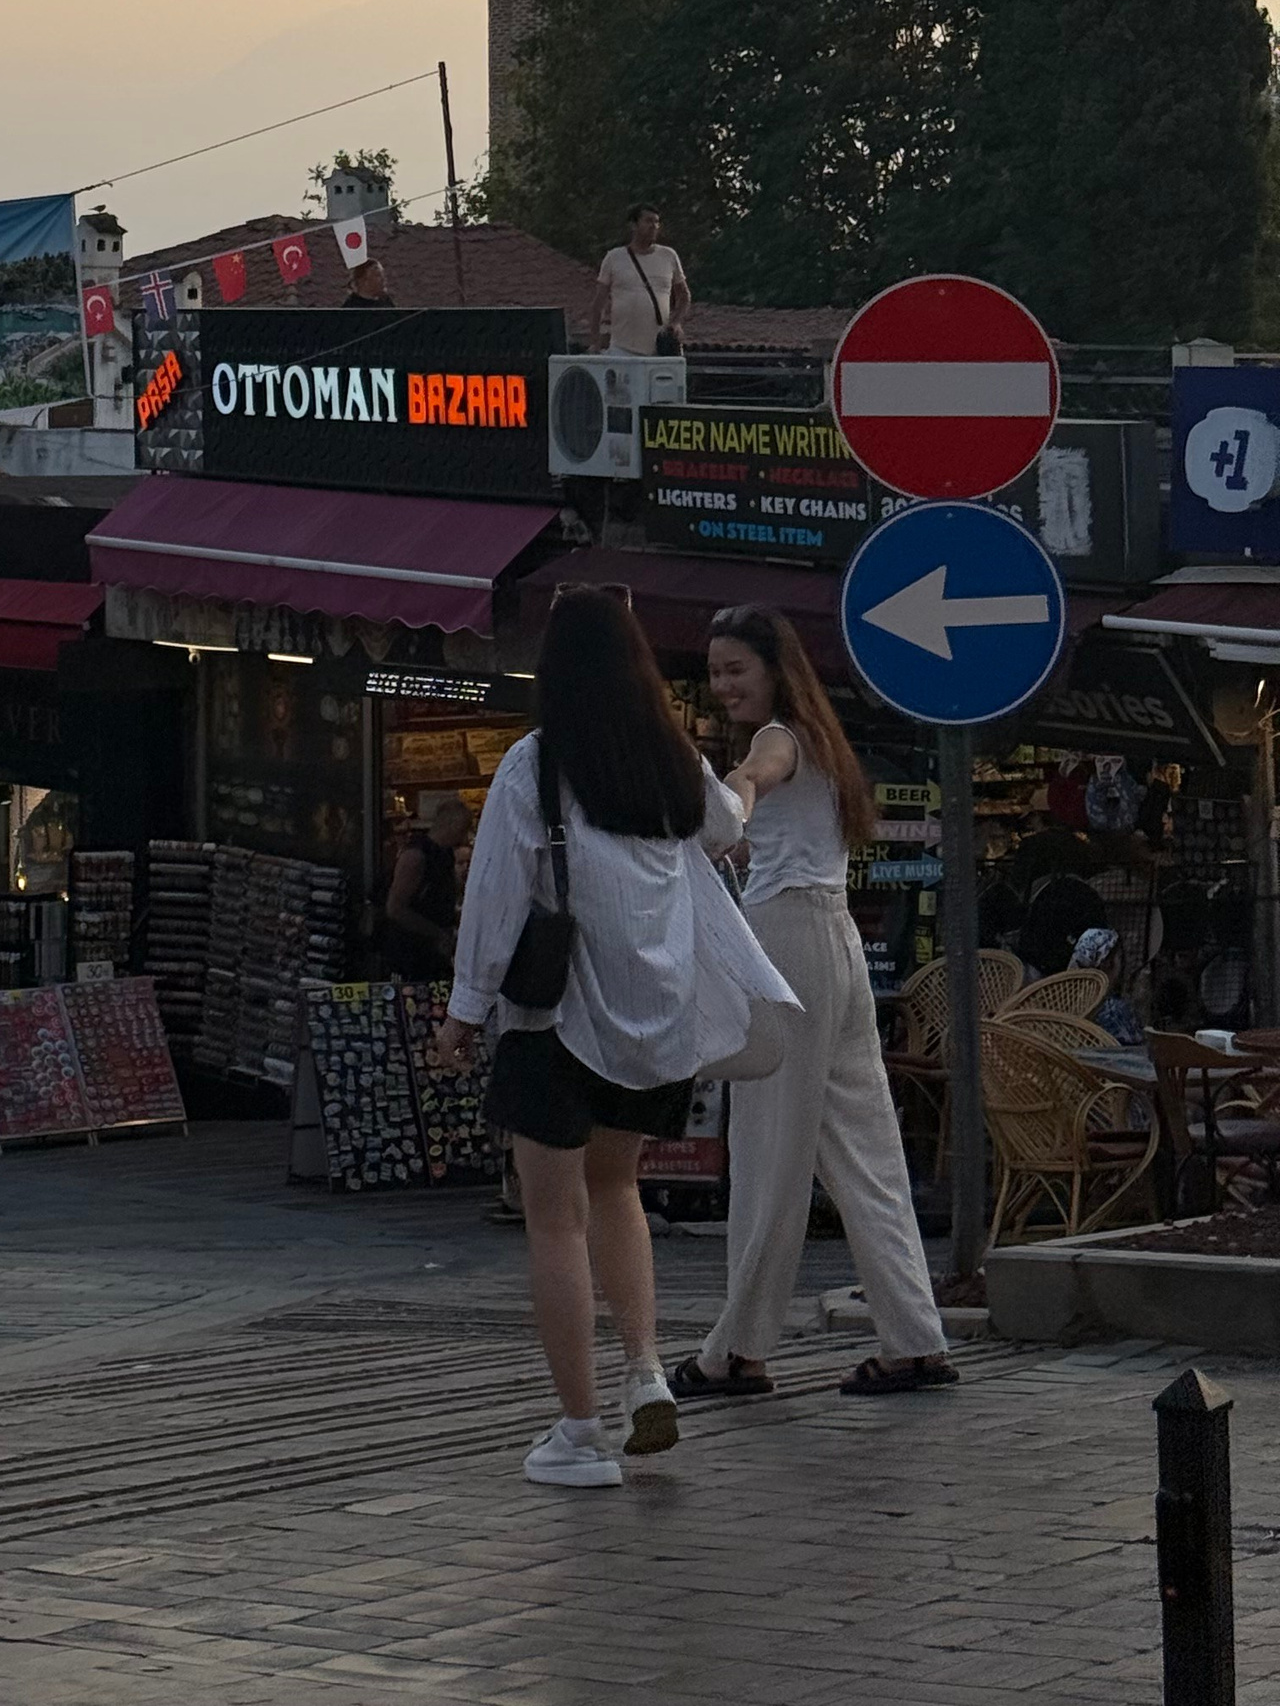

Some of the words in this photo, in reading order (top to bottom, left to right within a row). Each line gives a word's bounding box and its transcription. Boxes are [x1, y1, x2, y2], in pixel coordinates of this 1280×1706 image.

[211, 361, 398, 424] OTTOMAN
[407, 371, 528, 429] BAZAAR
[643, 418, 706, 452] LAZER
[709, 421, 770, 456] NAME
[1210, 430, 1250, 491] +1
[657, 488, 737, 511] LIGHTERS
[760, 496, 796, 515] KEY
[799, 499, 867, 521] CHAINS
[697, 519, 724, 538] ON
[726, 521, 776, 543] STEEL
[886, 788, 931, 802] BEER
[872, 865, 901, 879] LIVE
